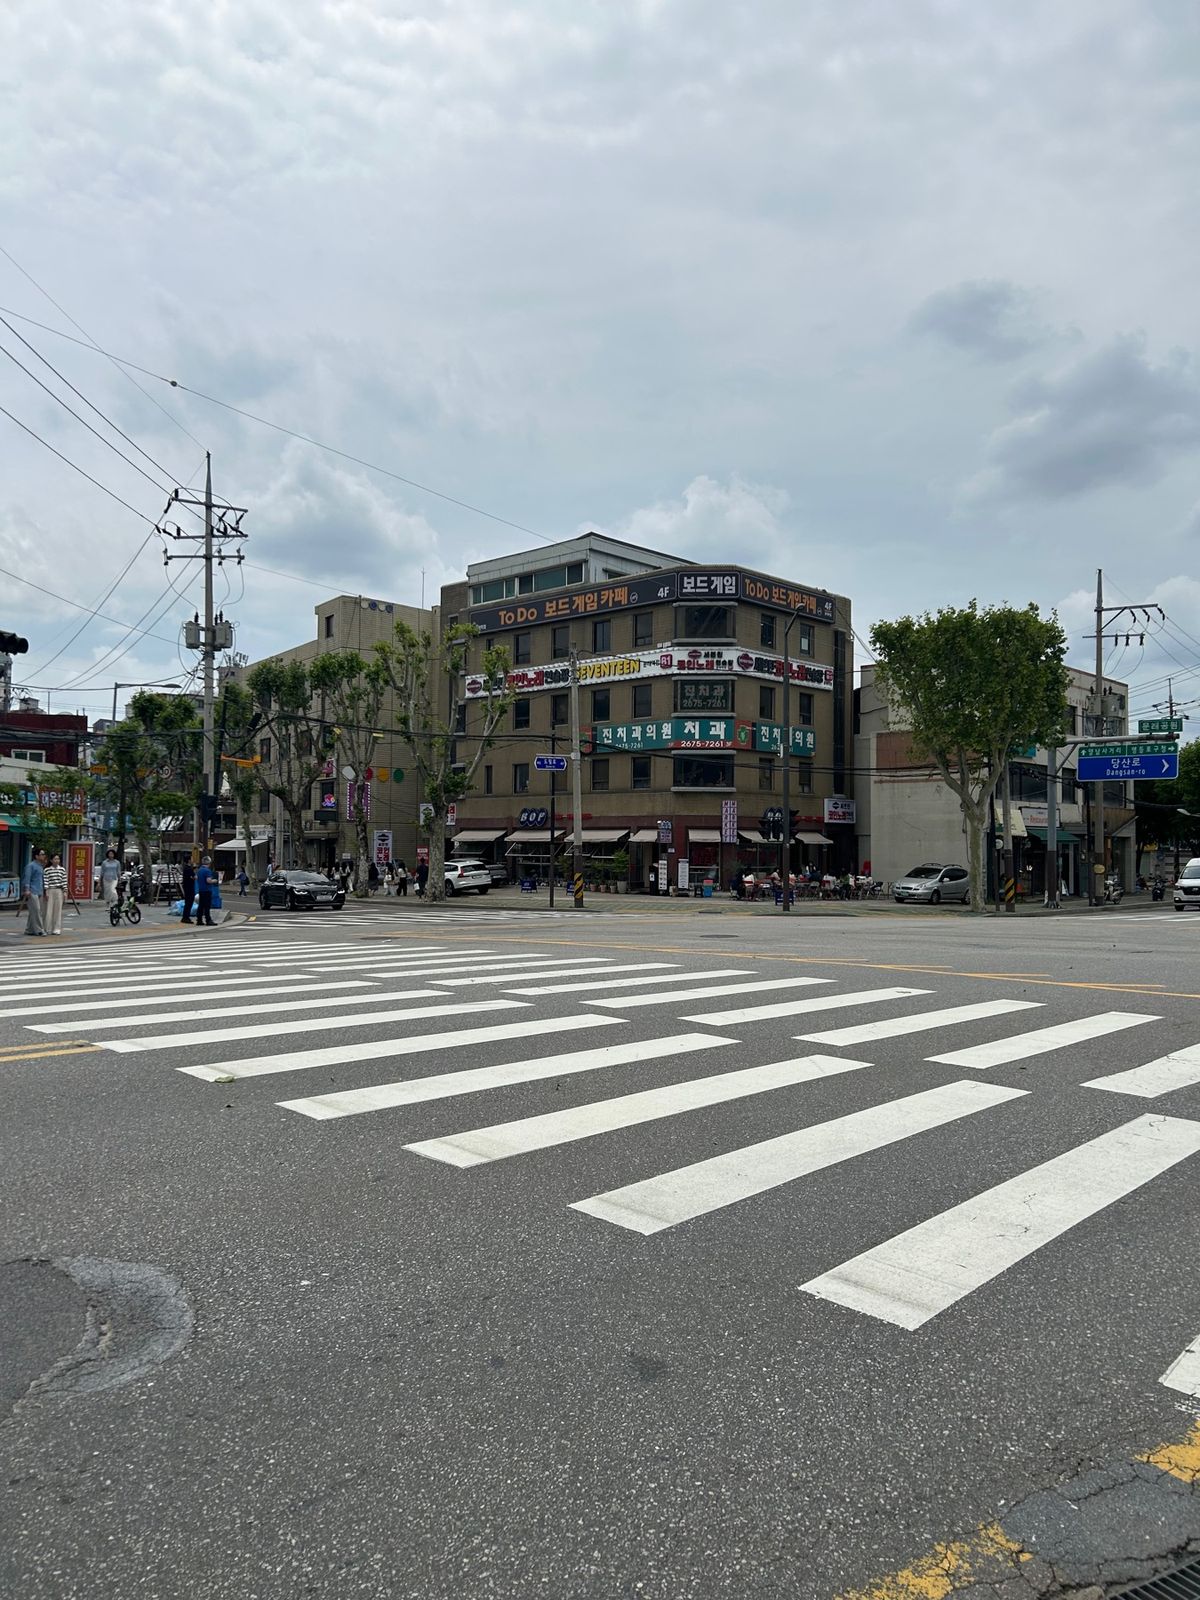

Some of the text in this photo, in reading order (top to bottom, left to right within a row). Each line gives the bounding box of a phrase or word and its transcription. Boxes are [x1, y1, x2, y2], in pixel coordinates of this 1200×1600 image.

[683, 576, 736, 593] 보드게임
[657, 587, 669, 598] 4F
[683, 699, 727, 708] 2675-7261
[602, 722, 672, 744] 진치과의원
[684, 720, 727, 740] 치과
[1111, 757, 1141, 769] 당산로
[1106, 769, 1146, 777] Dangsan-ro
